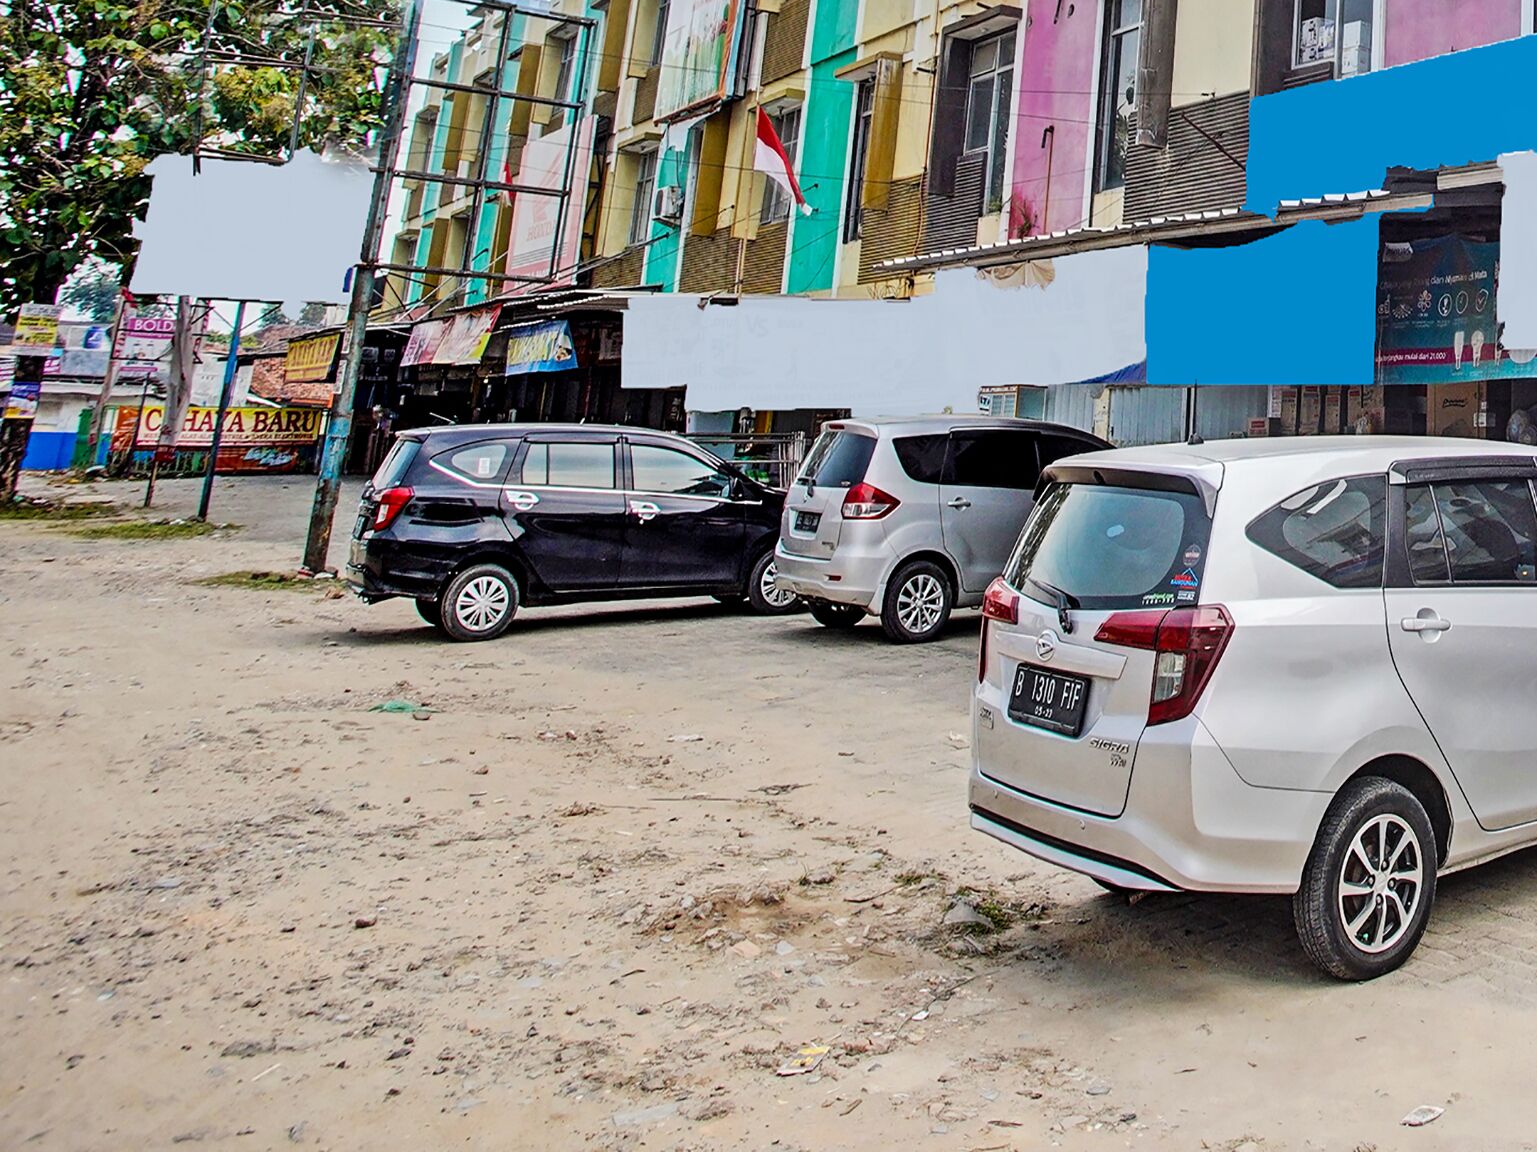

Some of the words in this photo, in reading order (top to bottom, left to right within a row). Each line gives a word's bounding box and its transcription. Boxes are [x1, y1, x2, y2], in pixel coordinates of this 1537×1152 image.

[1430, 275, 1445, 285] dan
[251, 409, 319, 434] BARU
[1015, 671, 1025, 696] B
[1031, 674, 1056, 705] 1310
[1060, 681, 1081, 710] FIF
[1089, 736, 1129, 754] SIGRA
